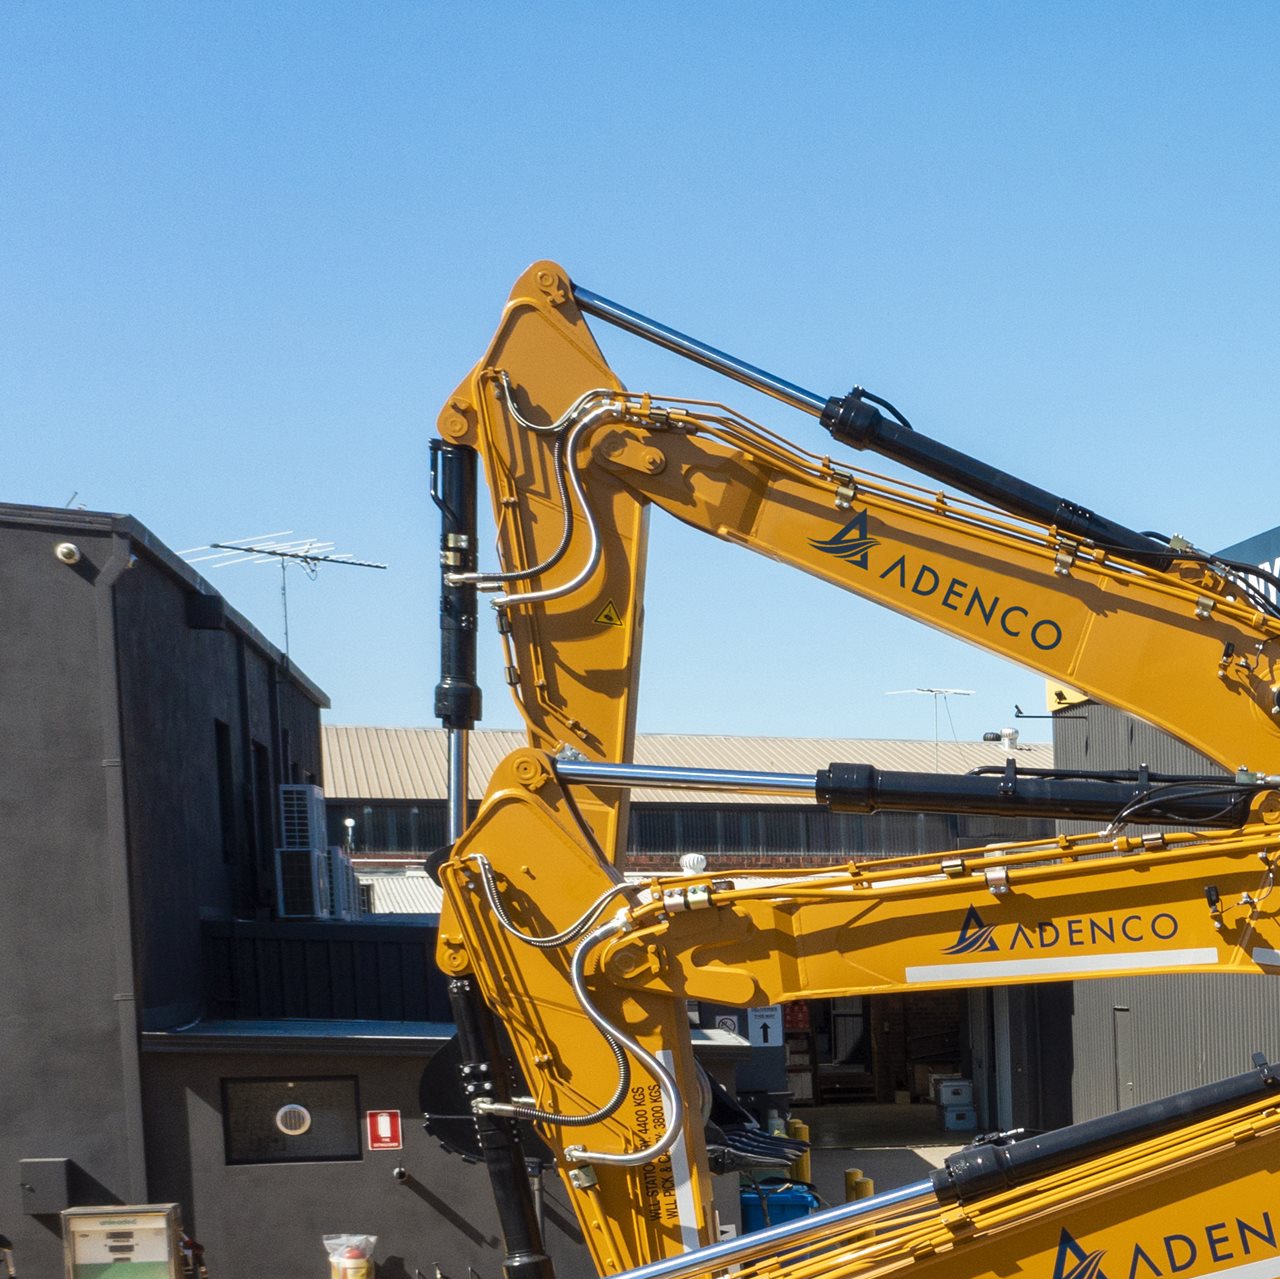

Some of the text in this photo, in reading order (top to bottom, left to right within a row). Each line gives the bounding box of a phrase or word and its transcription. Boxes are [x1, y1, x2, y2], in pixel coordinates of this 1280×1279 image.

[879, 554, 1062, 650] ADENCO
[1010, 913, 1179, 950] ADENCO
[648, 1084, 661, 1104] KGS
[652, 1107, 665, 1130] 3800
[632, 1086, 662, 1222] WLL STATIORY: 4400 KGS
[660, 1167, 672, 1176] &
[660, 1177, 676, 1198] PICK
[666, 1201, 679, 1220] WLL
